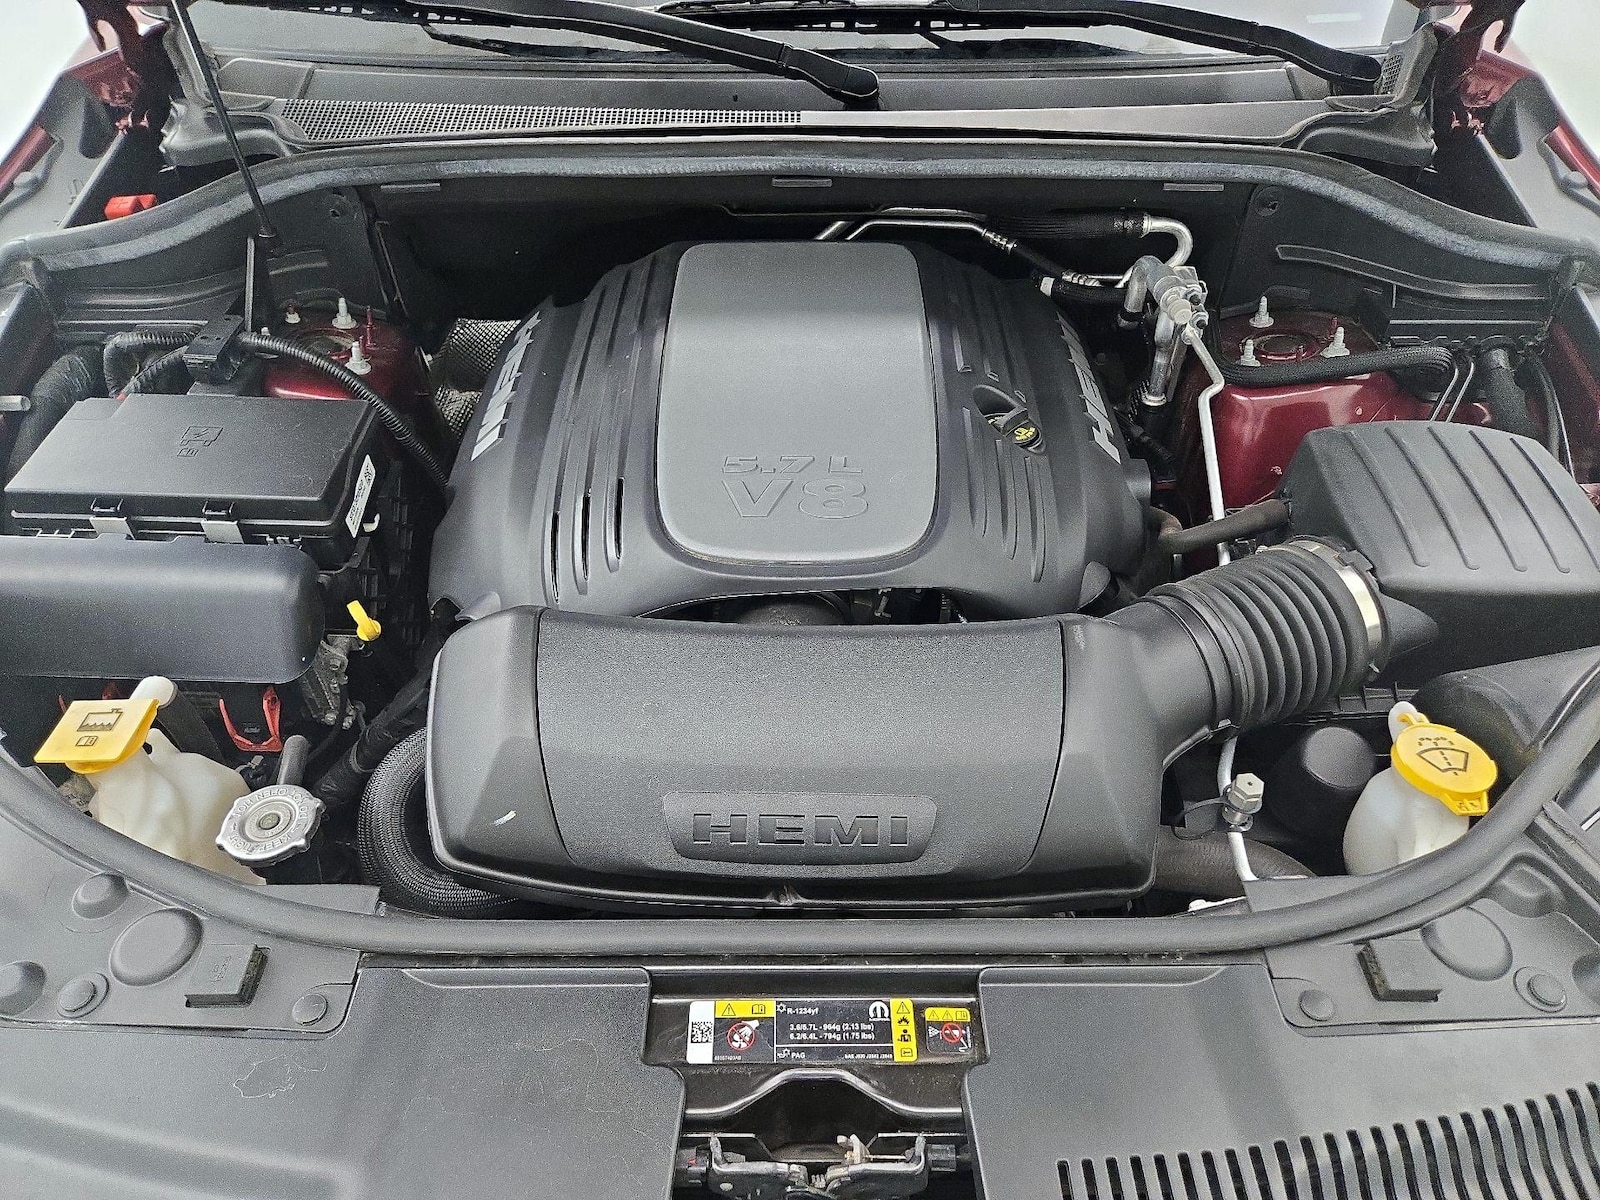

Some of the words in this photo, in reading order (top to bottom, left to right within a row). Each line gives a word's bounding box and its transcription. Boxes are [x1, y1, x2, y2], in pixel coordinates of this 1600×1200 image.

[470, 311, 541, 461] HEMI
[1056, 311, 1121, 464] HEMI
[721, 477, 869, 519] V8
[692, 814, 909, 847] HEMI
[823, 1023, 841, 1031] 964g
[842, 1023, 859, 1031] (2.13
[860, 1023, 874, 1031] lbs)
[861, 1032, 875, 1040] lbs)
